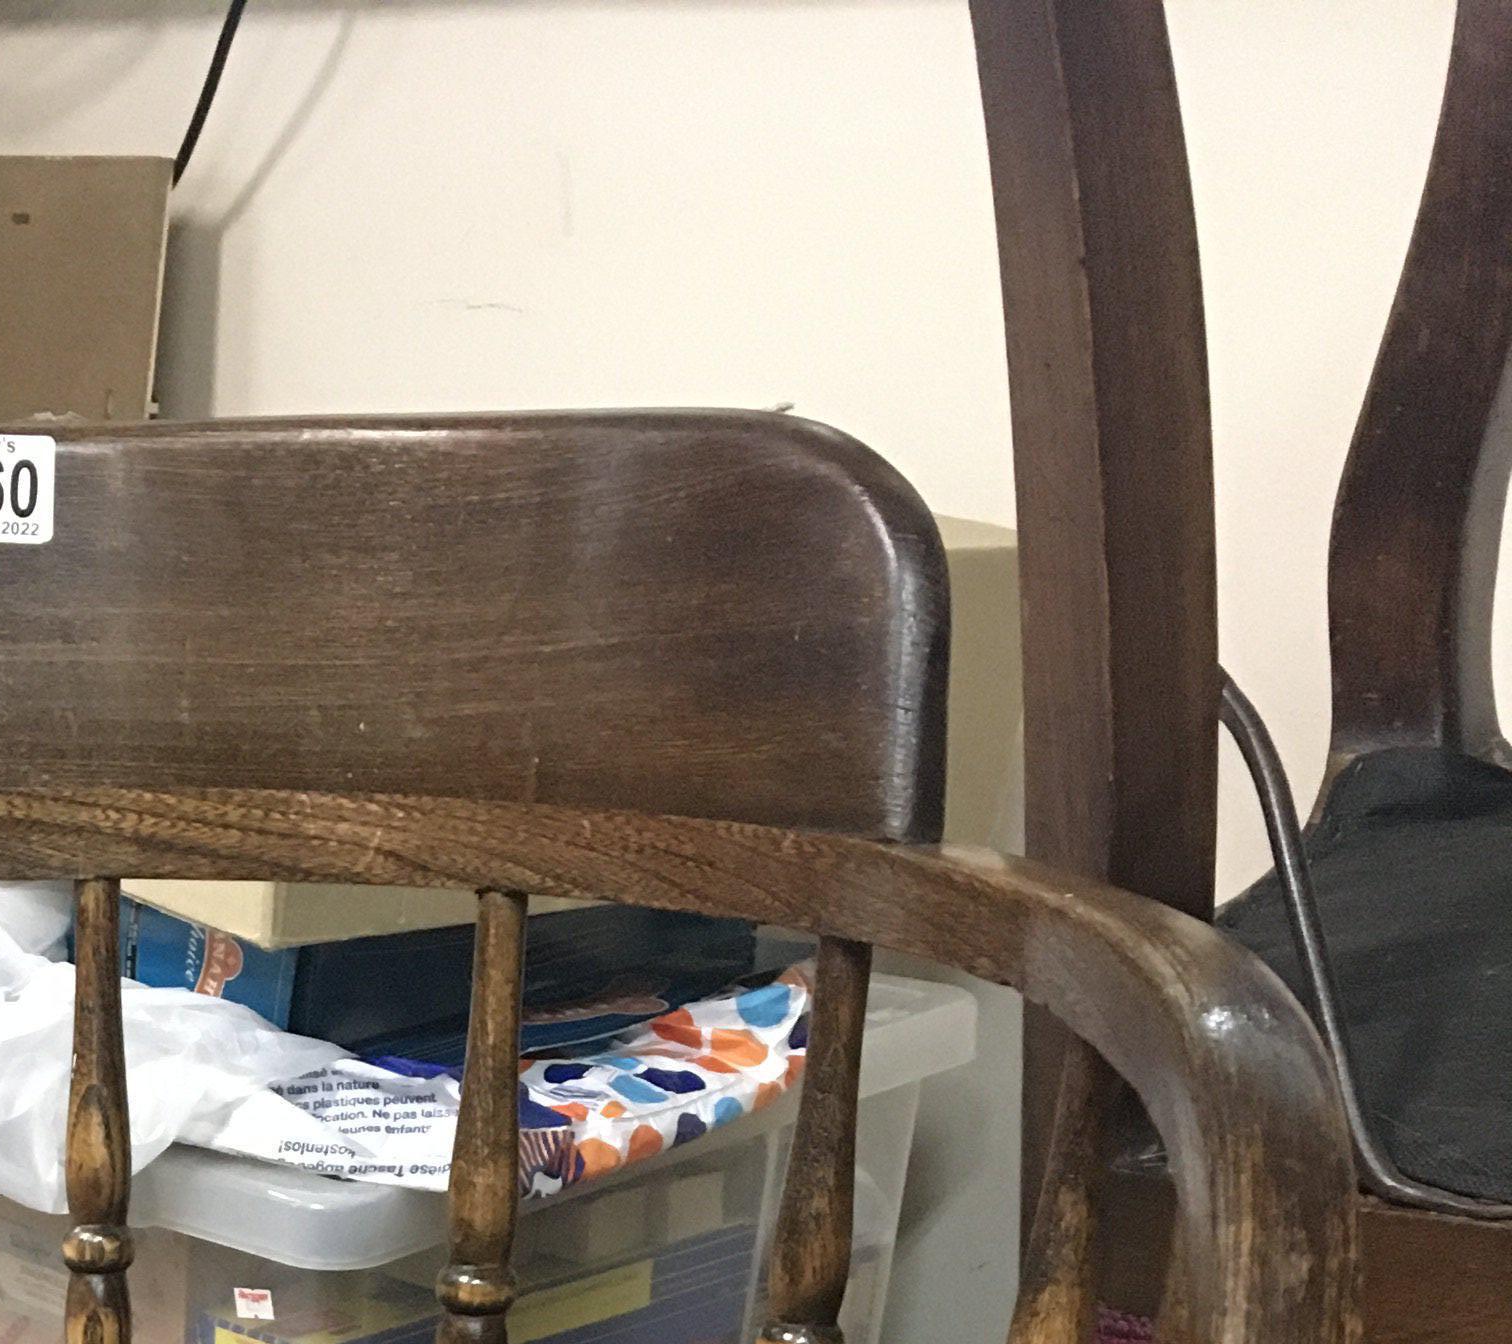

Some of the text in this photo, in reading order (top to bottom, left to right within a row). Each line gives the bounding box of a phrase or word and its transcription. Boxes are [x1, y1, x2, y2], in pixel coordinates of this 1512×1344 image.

[1, 521, 40, 536] 2022
[287, 1079, 318, 1095] dans
[337, 1079, 380, 1091] nature
[313, 1093, 380, 1112] plastiques
[383, 1092, 438, 1107] peuvent
